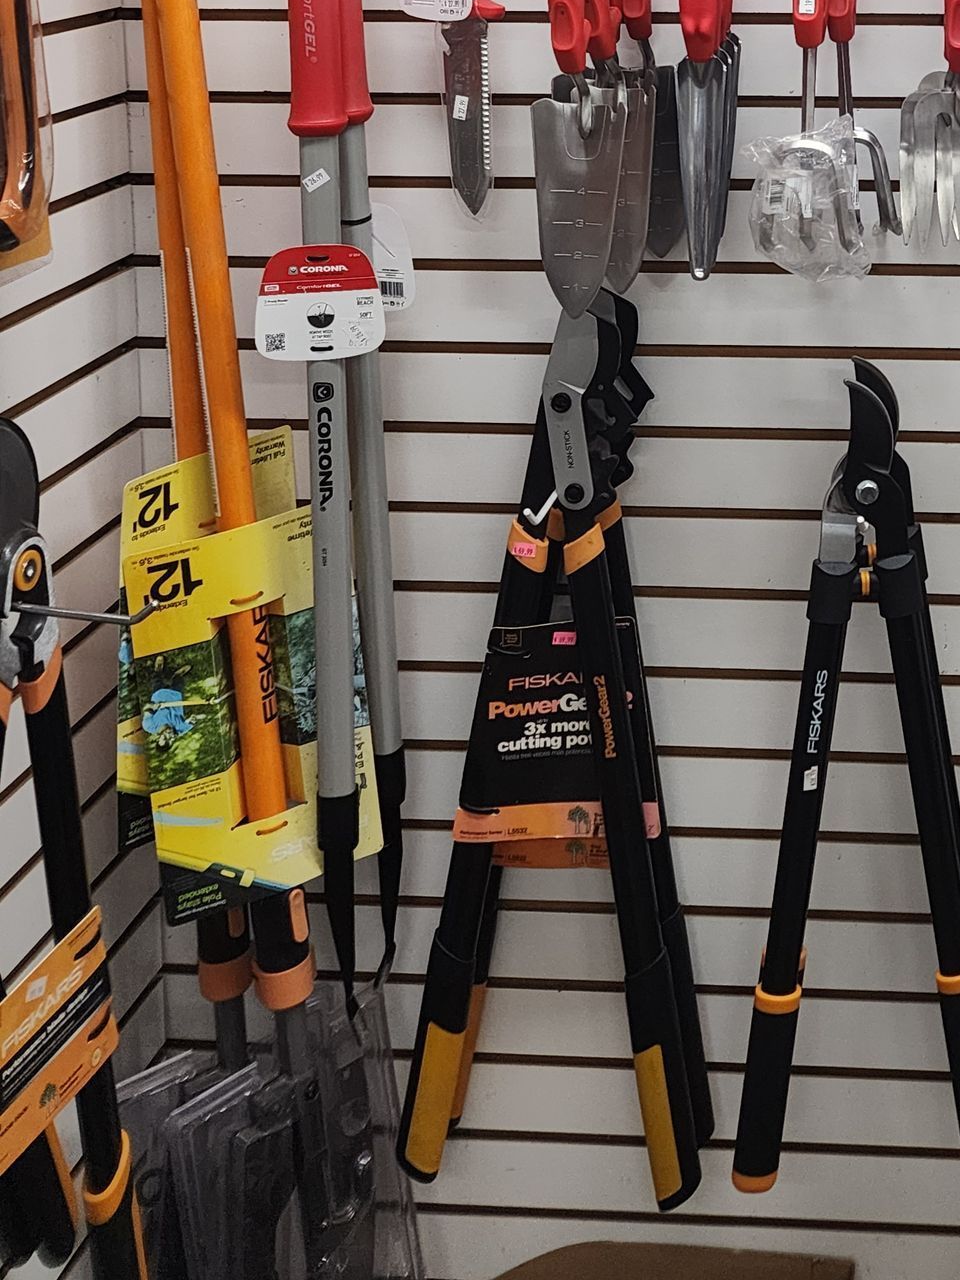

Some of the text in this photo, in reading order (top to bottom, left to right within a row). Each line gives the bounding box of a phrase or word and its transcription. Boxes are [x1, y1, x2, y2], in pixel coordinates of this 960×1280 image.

[576, 187, 586, 195] 4
[617, 198, 626, 207] 3
[575, 219, 584, 228] 3
[616, 229, 625, 238] 2
[572, 251, 583, 260] 2
[299, 265, 349, 274] CORONA
[296, 283, 342, 291] ComfortGEL
[255, 440, 286, 455] Warranty
[563, 430, 575, 469] NON-STICK
[250, 449, 286, 466] Full Lifeti
[317, 407, 334, 507] CORONA
[132, 481, 180, 534] 12'
[131, 523, 166, 542] Extends to
[287, 529, 313, 542] fetime
[143, 556, 203, 607] 12'
[252, 606, 279, 724] FISKA
[508, 671, 584, 692] FISKA
[488, 693, 588, 720] PowerGe
[806, 669, 829, 754] FISKARS
[592, 674, 617, 759] PowerGear2
[524, 721, 547, 736] 3x
[497, 734, 563, 753] cutting
[202, 891, 223, 905] Pole
[1, 963, 84, 1061] FISKARS
